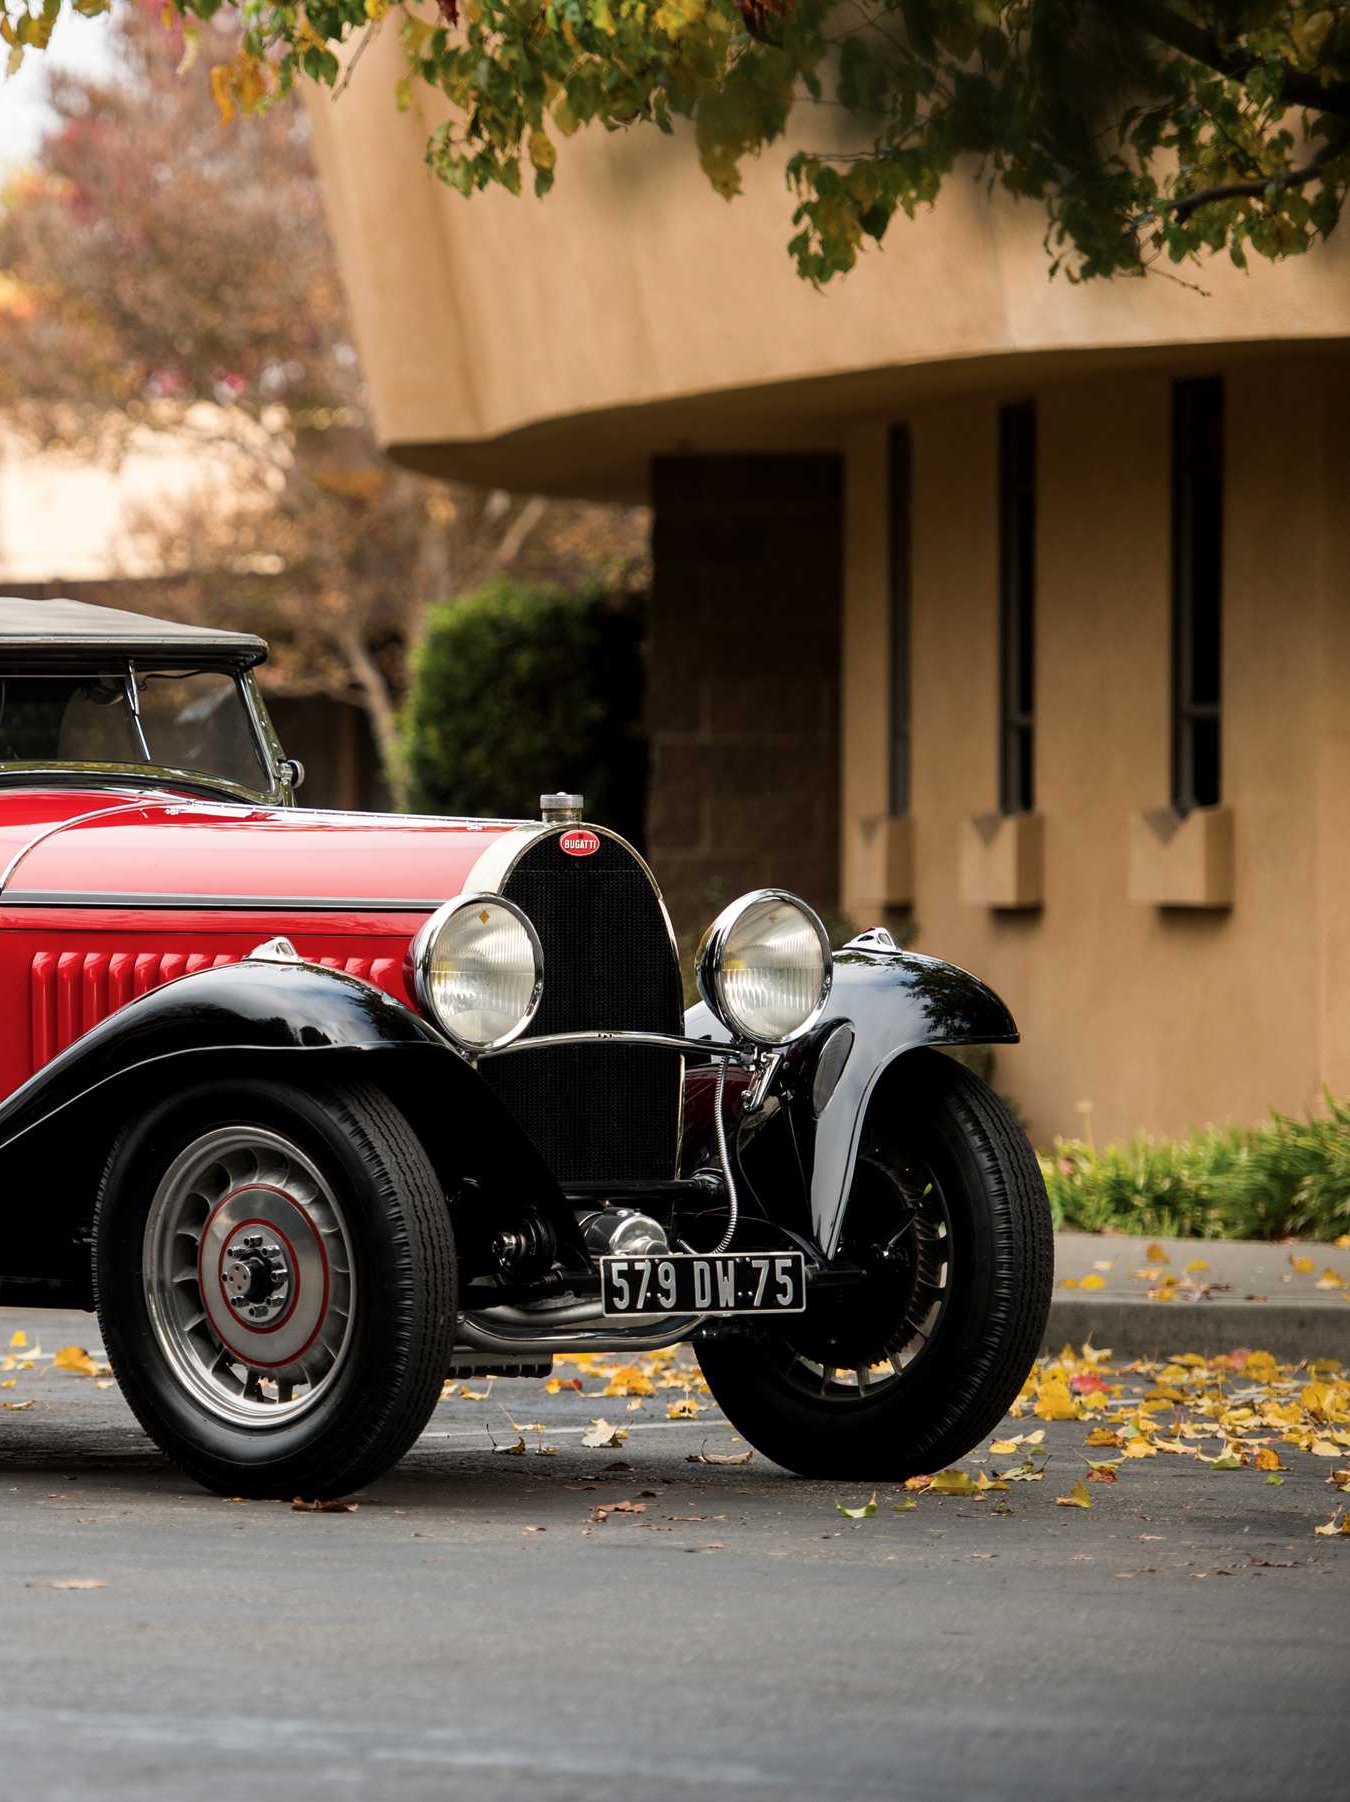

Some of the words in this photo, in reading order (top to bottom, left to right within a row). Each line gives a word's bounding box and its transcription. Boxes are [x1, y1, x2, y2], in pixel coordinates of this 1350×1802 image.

[564, 839, 596, 849] BUGATTI
[611, 1261, 677, 1310] 579
[693, 1260, 735, 1308] DW
[752, 1259, 794, 1306] 75
